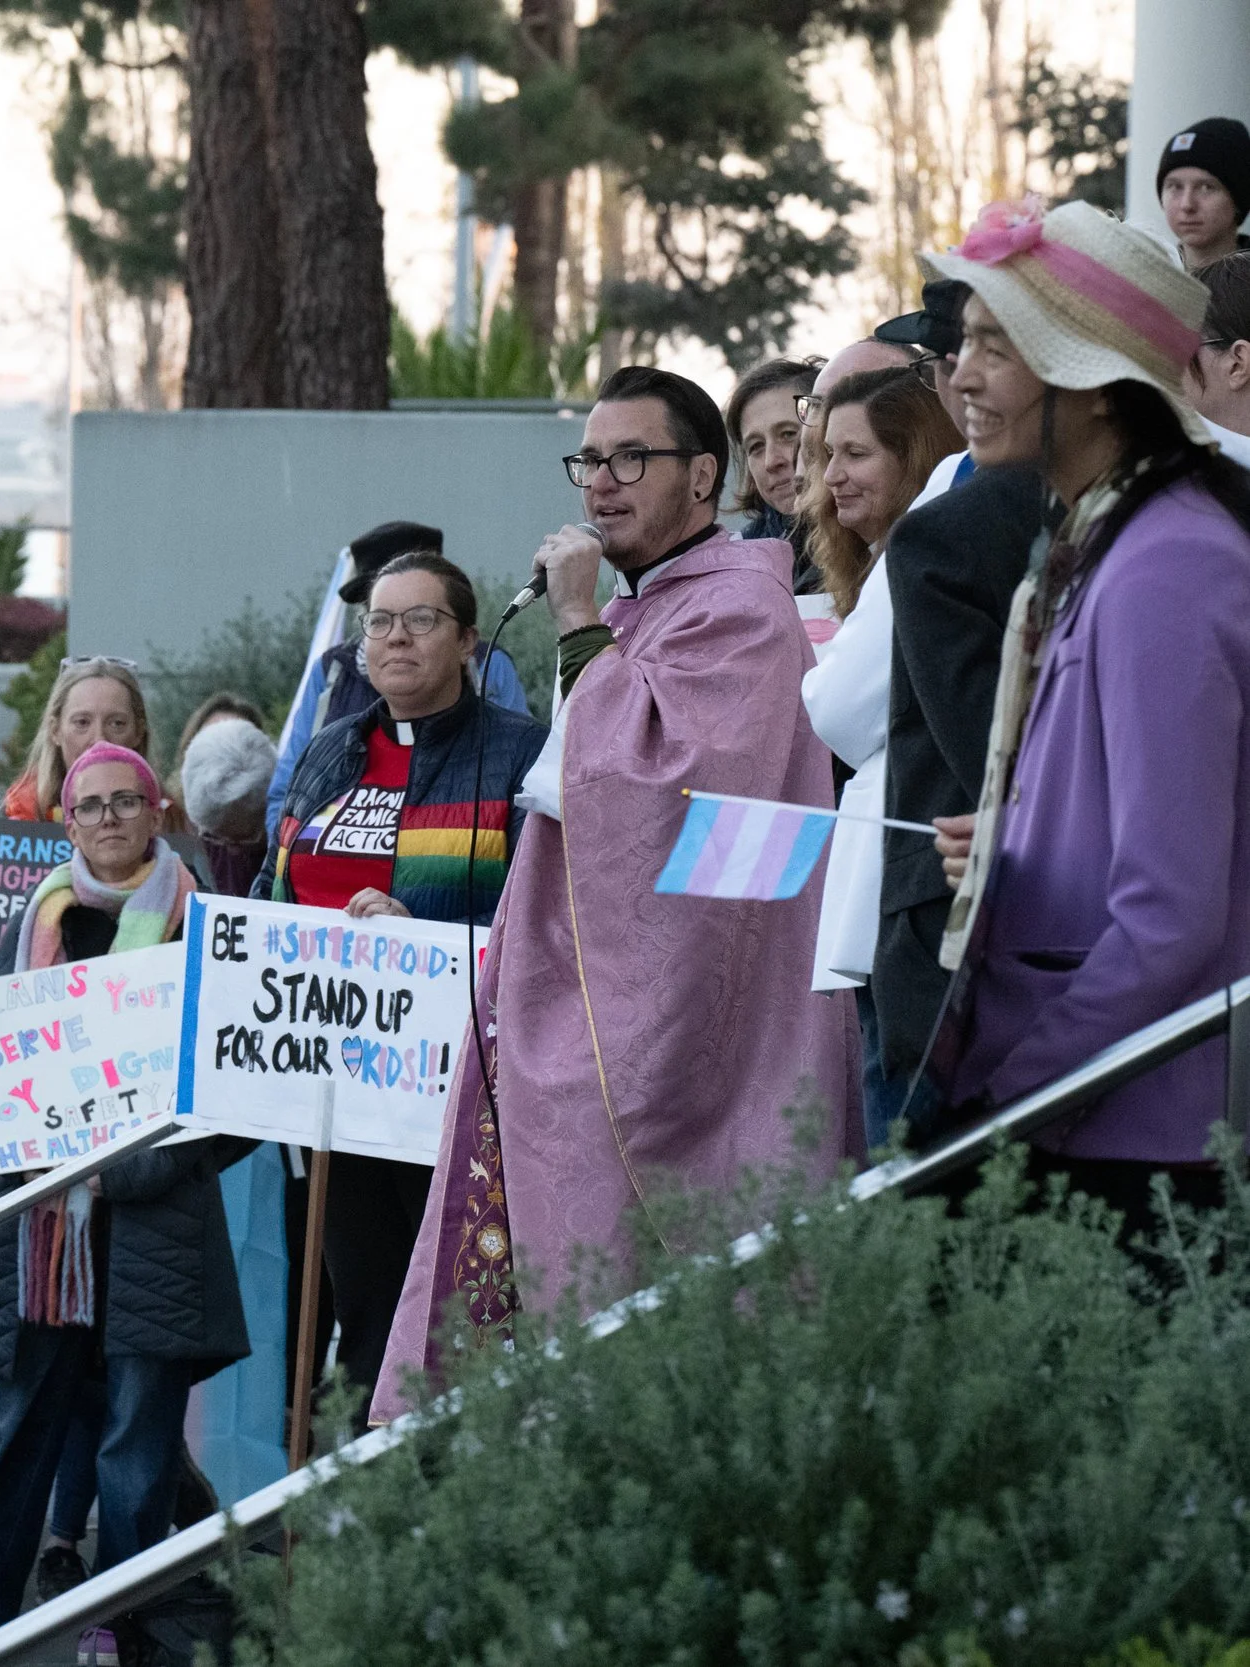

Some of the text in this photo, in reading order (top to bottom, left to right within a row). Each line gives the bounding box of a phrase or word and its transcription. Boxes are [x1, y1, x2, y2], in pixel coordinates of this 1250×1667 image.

[211, 913, 459, 979] BE #SUTTERPROUD:
[252, 967, 414, 1034] STAND UP
[215, 1024, 268, 1073] FOR
[272, 1032, 333, 1077] OUR
[44, 1082, 161, 1130] SAFETY
